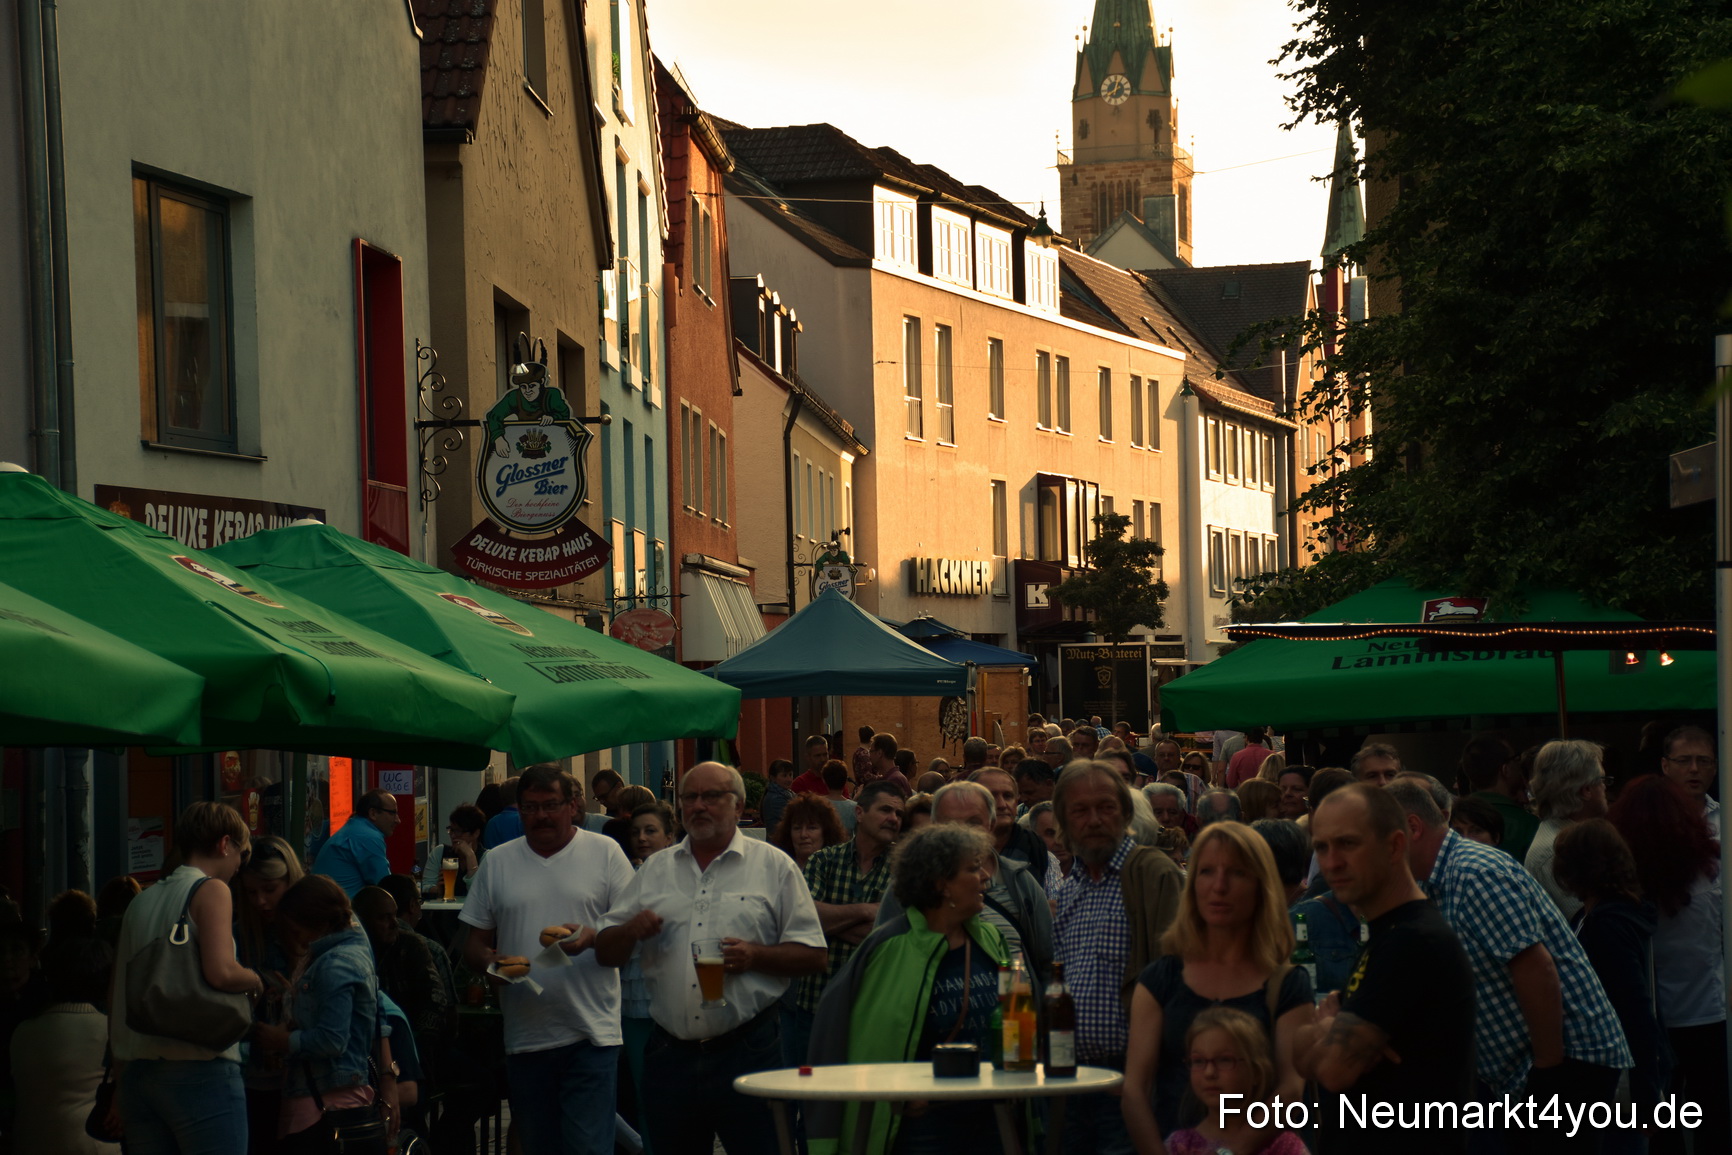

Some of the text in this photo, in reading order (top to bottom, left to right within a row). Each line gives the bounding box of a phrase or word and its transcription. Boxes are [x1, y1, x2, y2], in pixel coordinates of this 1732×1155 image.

[496, 456, 569, 497] Glossner
[534, 479, 569, 496] Bier
[144, 503, 209, 550] DELUXE
[469, 532, 593, 564] DELUXE KEBAP HAUS
[465, 554, 600, 581] TÜRKISCHE SPEZIALITÄTEN
[912, 557, 993, 595] HACKNER
[1367, 639, 1424, 653] Neu
[383, 772, 403, 783] WC
[934, 971, 997, 995] IAMONDS
[930, 992, 998, 1016] ADVNTU
